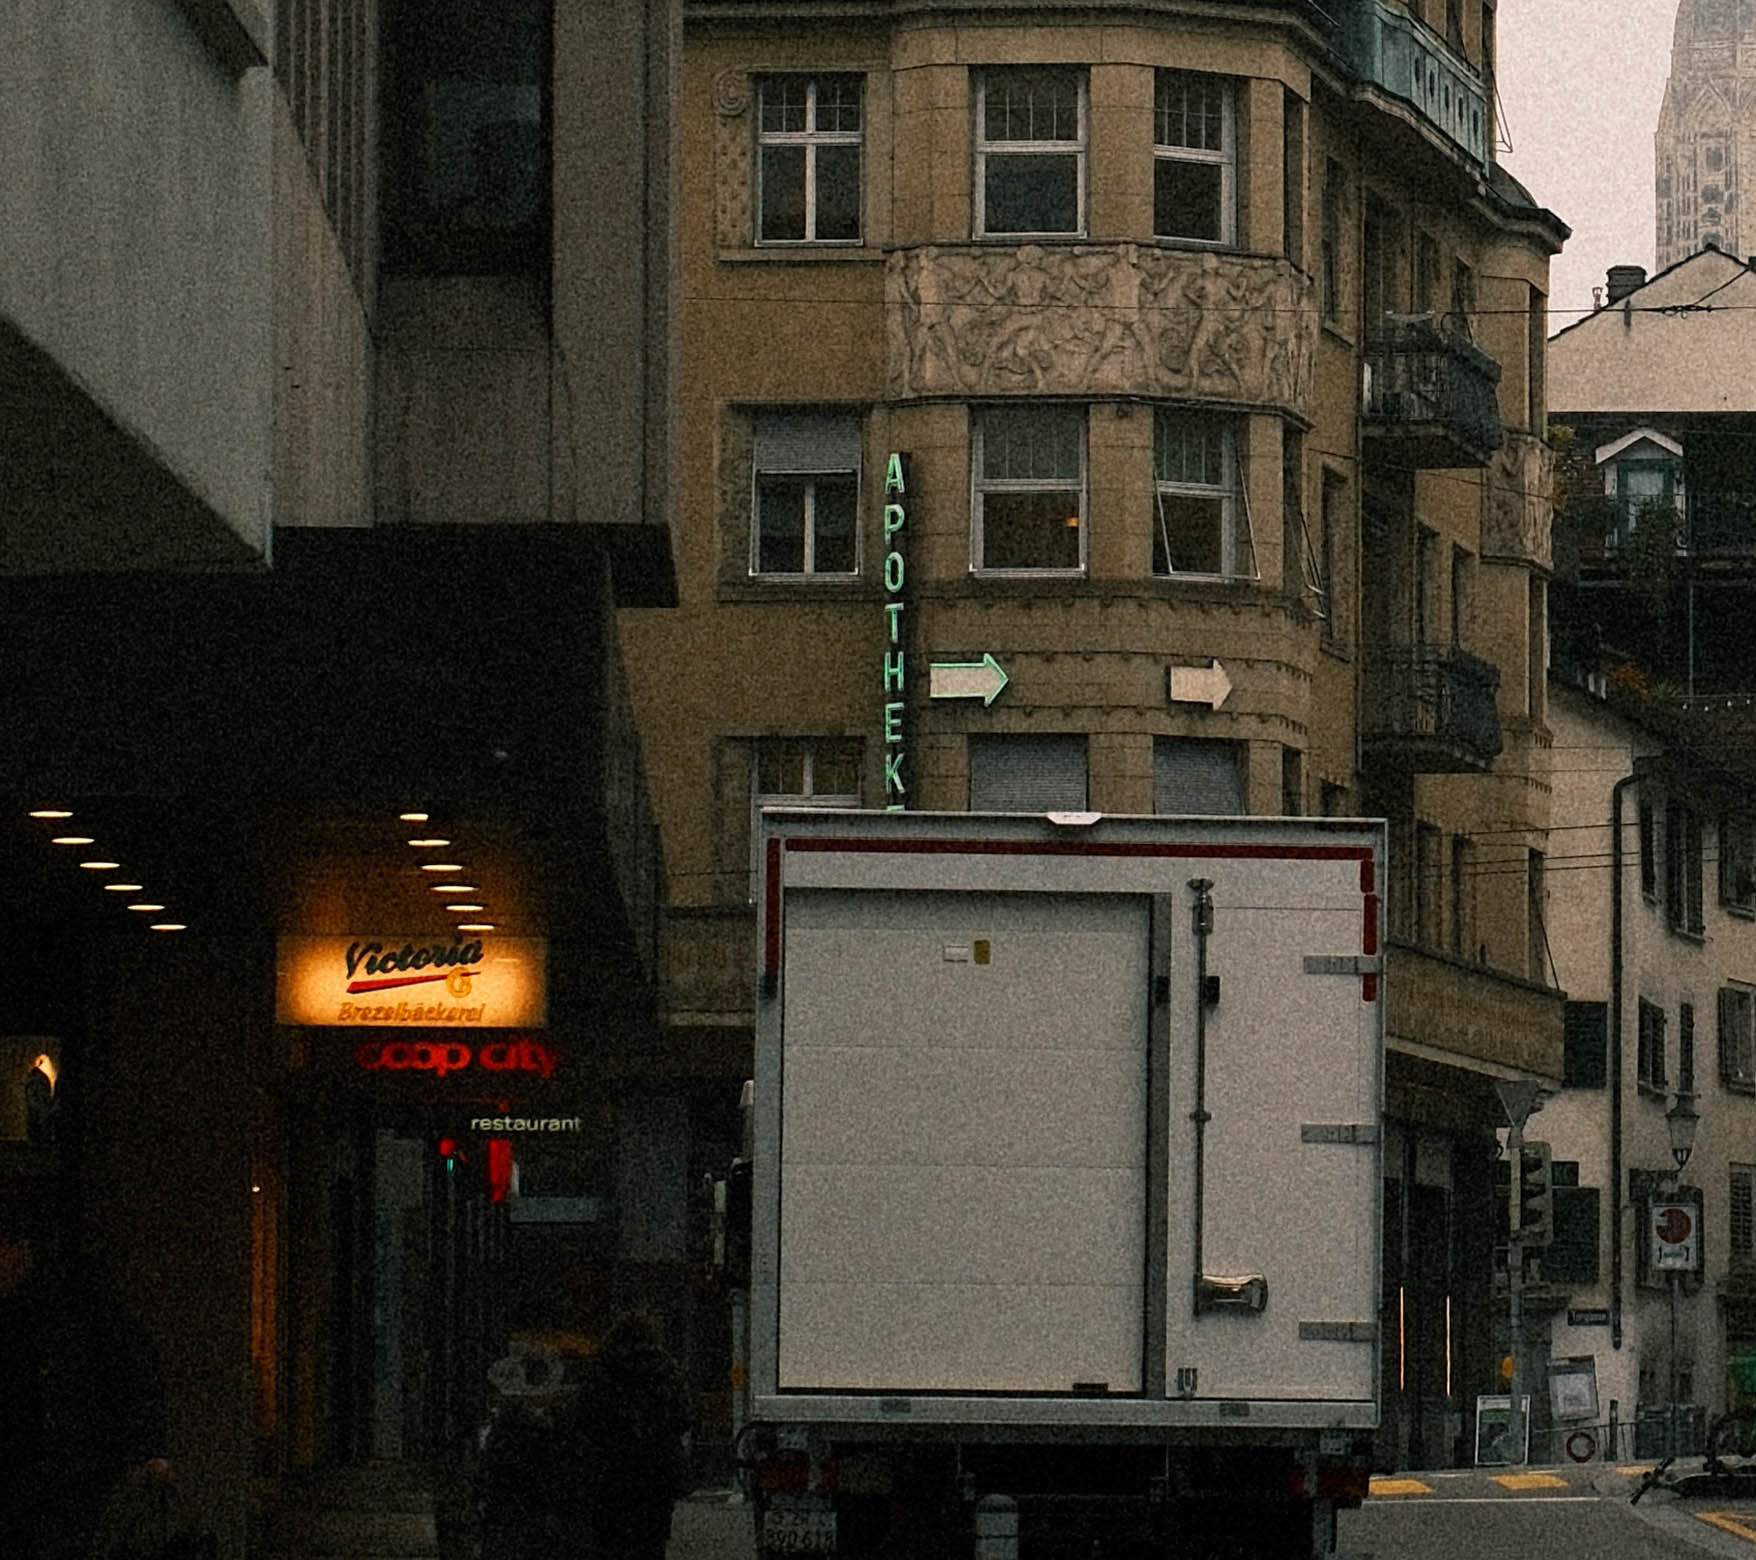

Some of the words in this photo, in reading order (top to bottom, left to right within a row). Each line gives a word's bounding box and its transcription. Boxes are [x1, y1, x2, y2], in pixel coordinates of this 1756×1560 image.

[884, 452, 906, 811] APOTHEK
[345, 937, 485, 980] Victoria
[337, 1002, 486, 1023] Brezelbäckerei
[355, 1041, 472, 1077] coop
[479, 1036, 557, 1078] city
[471, 1116, 581, 1131] restaurant
